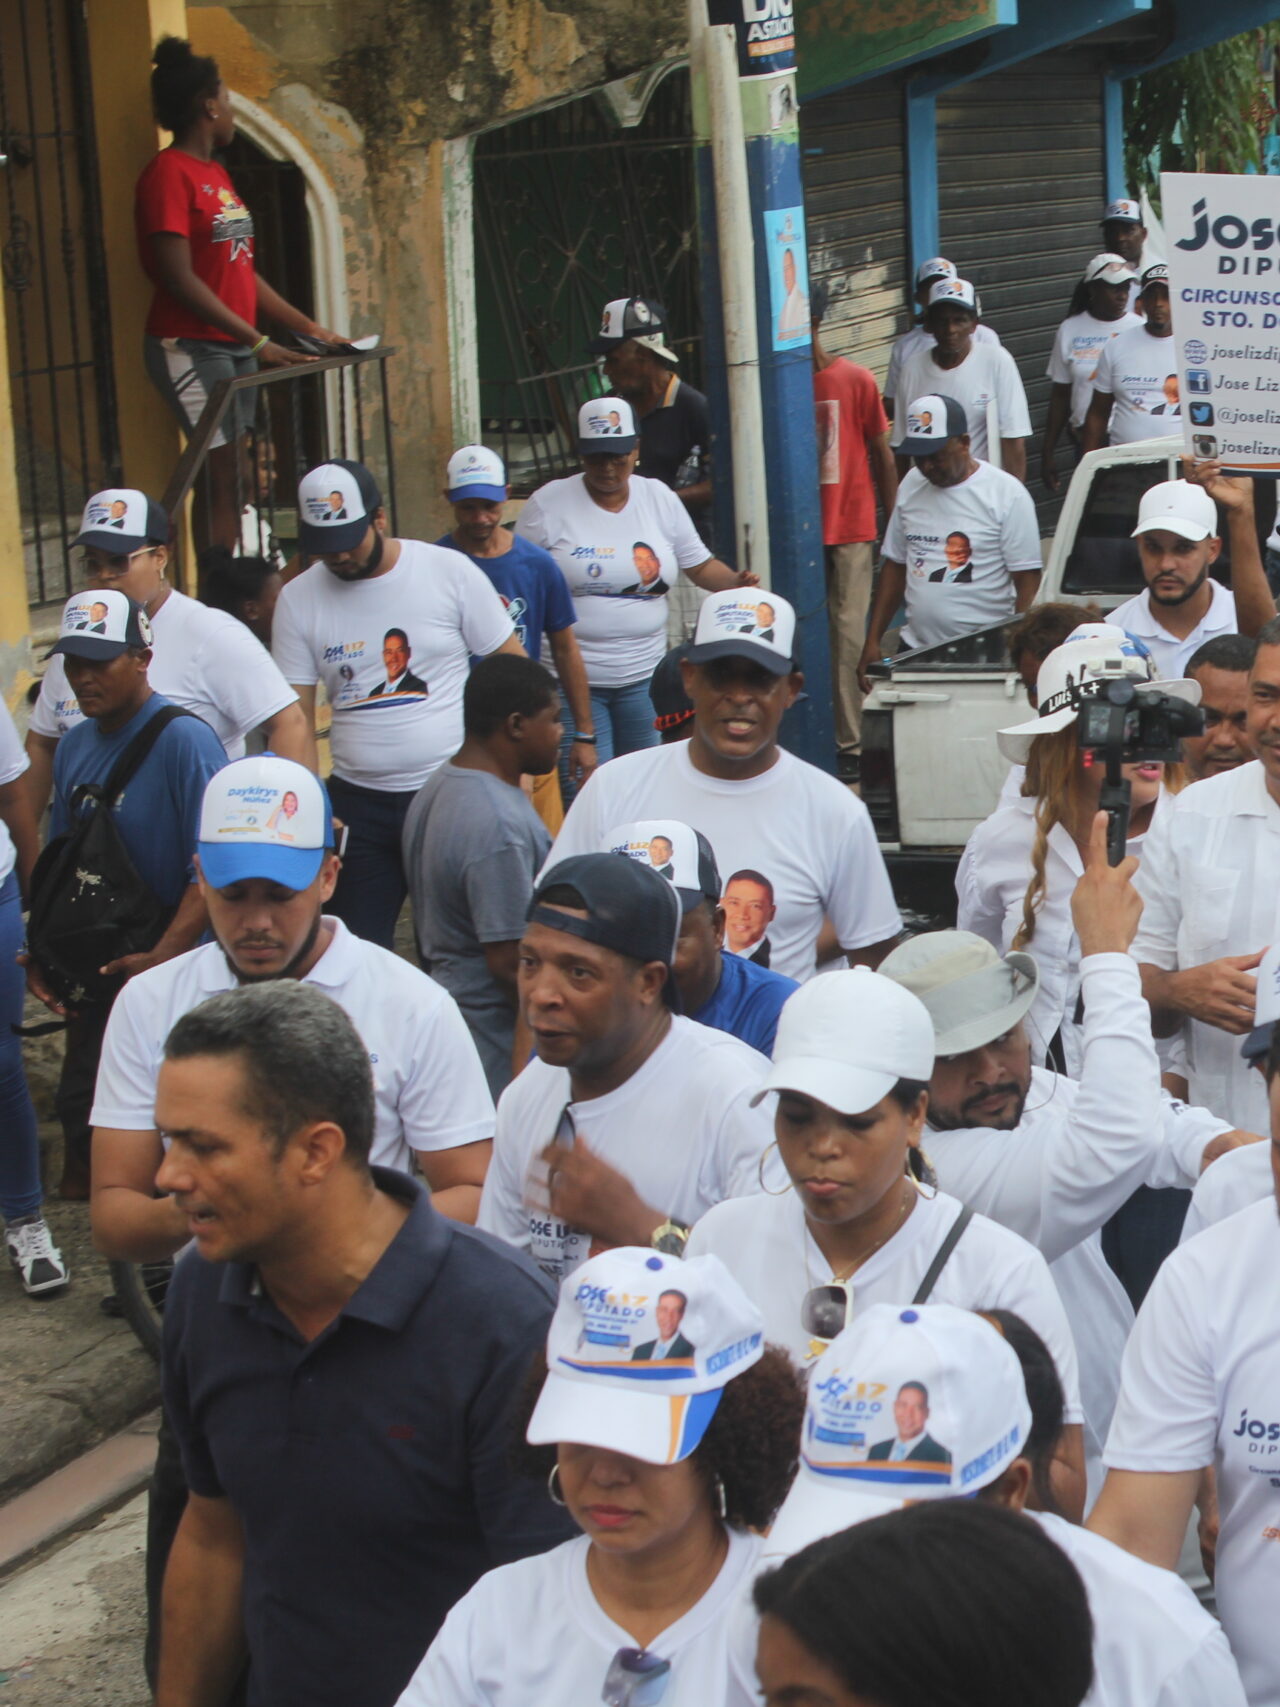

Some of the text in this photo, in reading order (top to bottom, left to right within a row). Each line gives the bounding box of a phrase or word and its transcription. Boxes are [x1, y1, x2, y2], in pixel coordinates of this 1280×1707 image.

[1203, 311, 1253, 328] STO.
[1215, 375, 1279, 392] Jose Liz
[228, 786, 279, 798] Daykirys
